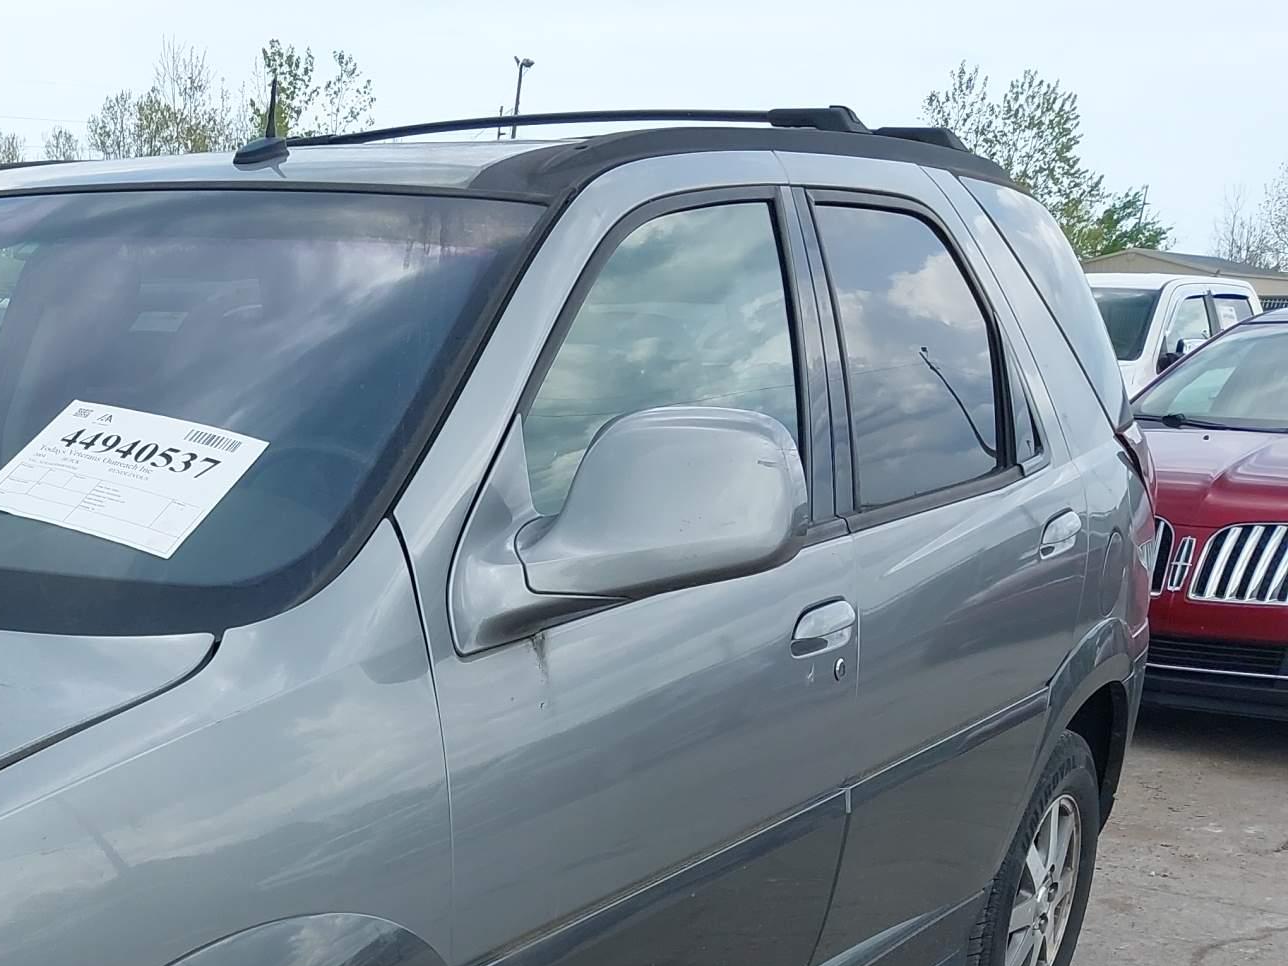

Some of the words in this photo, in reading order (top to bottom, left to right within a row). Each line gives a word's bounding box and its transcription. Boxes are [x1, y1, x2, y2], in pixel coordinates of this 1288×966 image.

[61, 428, 222, 479] 44940537
[68, 449, 101, 463] Veterans
[102, 456, 139, 470] Outreach
[1021, 754, 1077, 854] UNIROYAL
